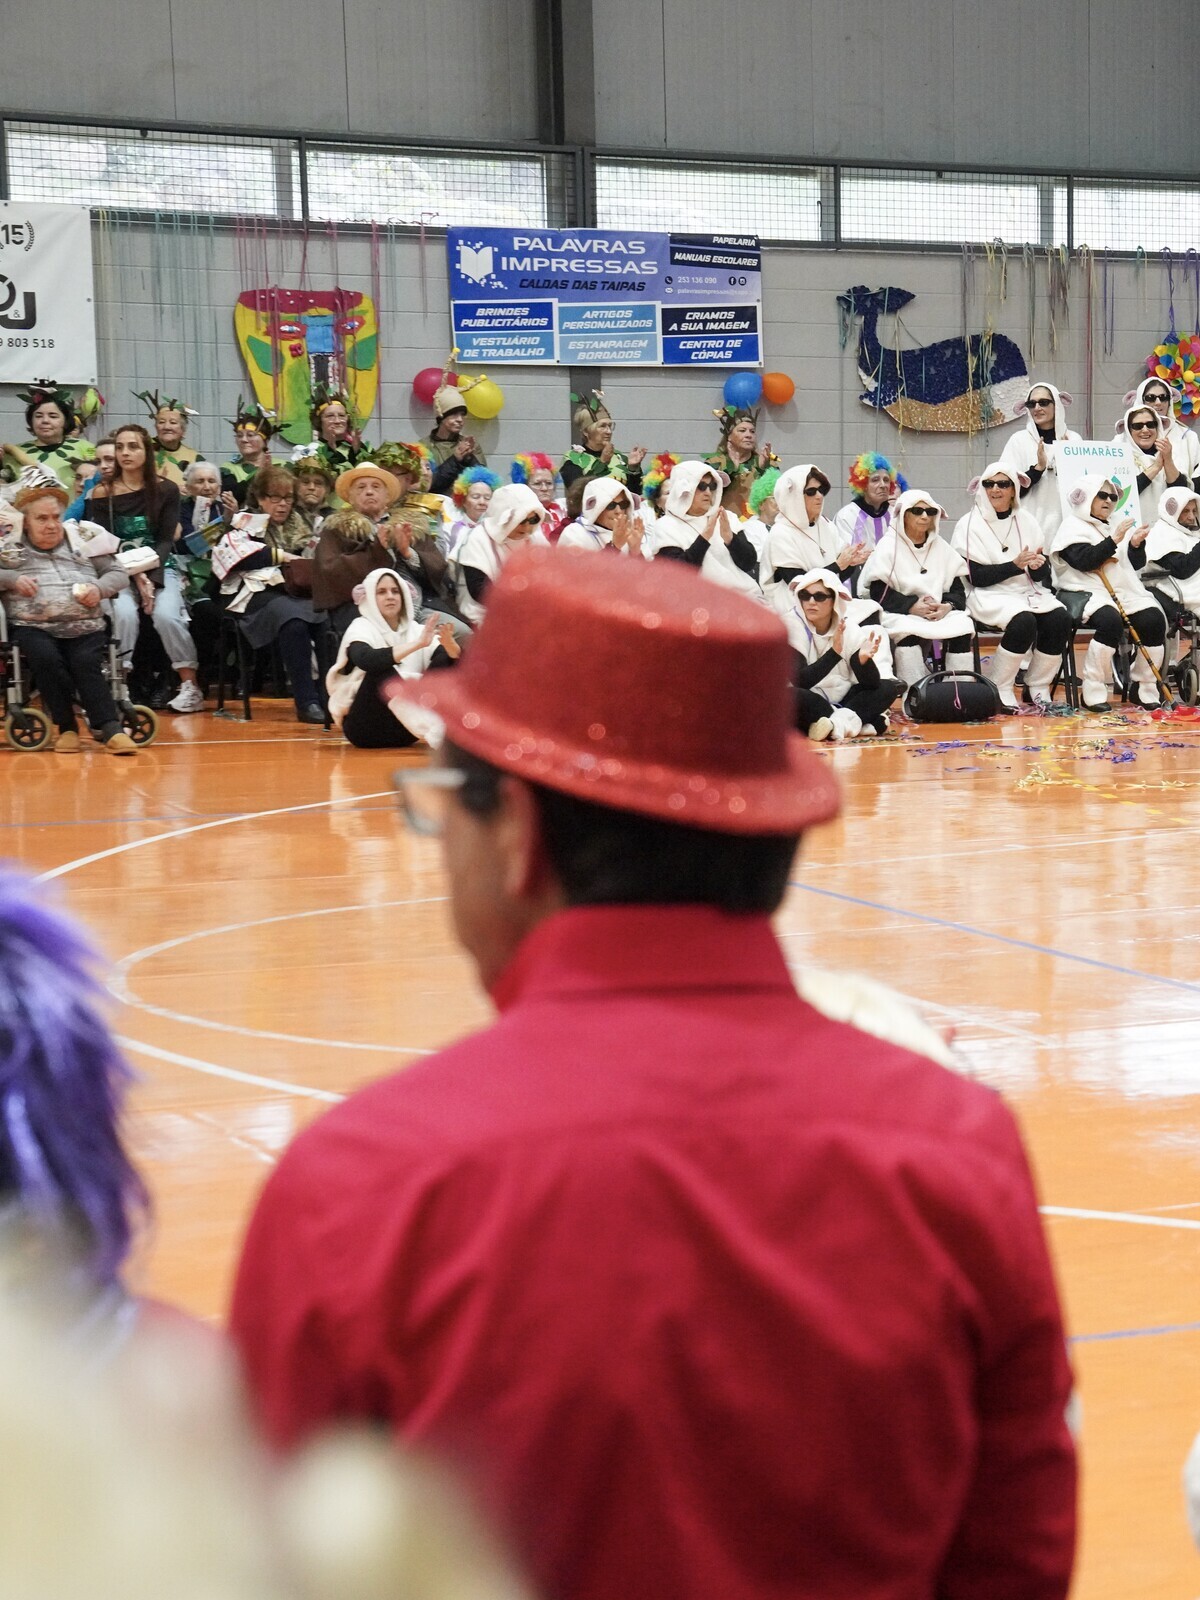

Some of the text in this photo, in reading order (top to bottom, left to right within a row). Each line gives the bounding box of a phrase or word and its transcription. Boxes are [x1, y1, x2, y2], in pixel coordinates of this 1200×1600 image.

[513, 237, 646, 254] PALAVRAS
[712, 236, 756, 246] PAPELARIA
[674, 252, 758, 266] MANUAIS ESCOLARES
[501, 256, 659, 274] IMPRESSAS
[519, 278, 646, 291] CALDAS DAS TAIPAS
[475, 307, 530, 316] BRINDES
[582, 310, 633, 319] ARTIGOS
[685, 311, 735, 320] CRIAMOS
[460, 316, 549, 327] PUBLICITÁRIOS
[562, 319, 653, 330] PERSONALIZADOS
[668, 321, 750, 331] A SUA IMAGEM
[7, 337, 28, 347] 803
[32, 338, 55, 348] 518
[472, 335, 540, 346] VESTUÁRIO
[567, 339, 648, 350] ESTAMPAGEM
[679, 339, 743, 349] CENTRO DE
[463, 347, 545, 358] DE TRABALHO
[577, 350, 641, 360] BORDADOS
[691, 349, 733, 360] CÓPIAS
[1063, 446, 1124, 457] GUIMARÃES
